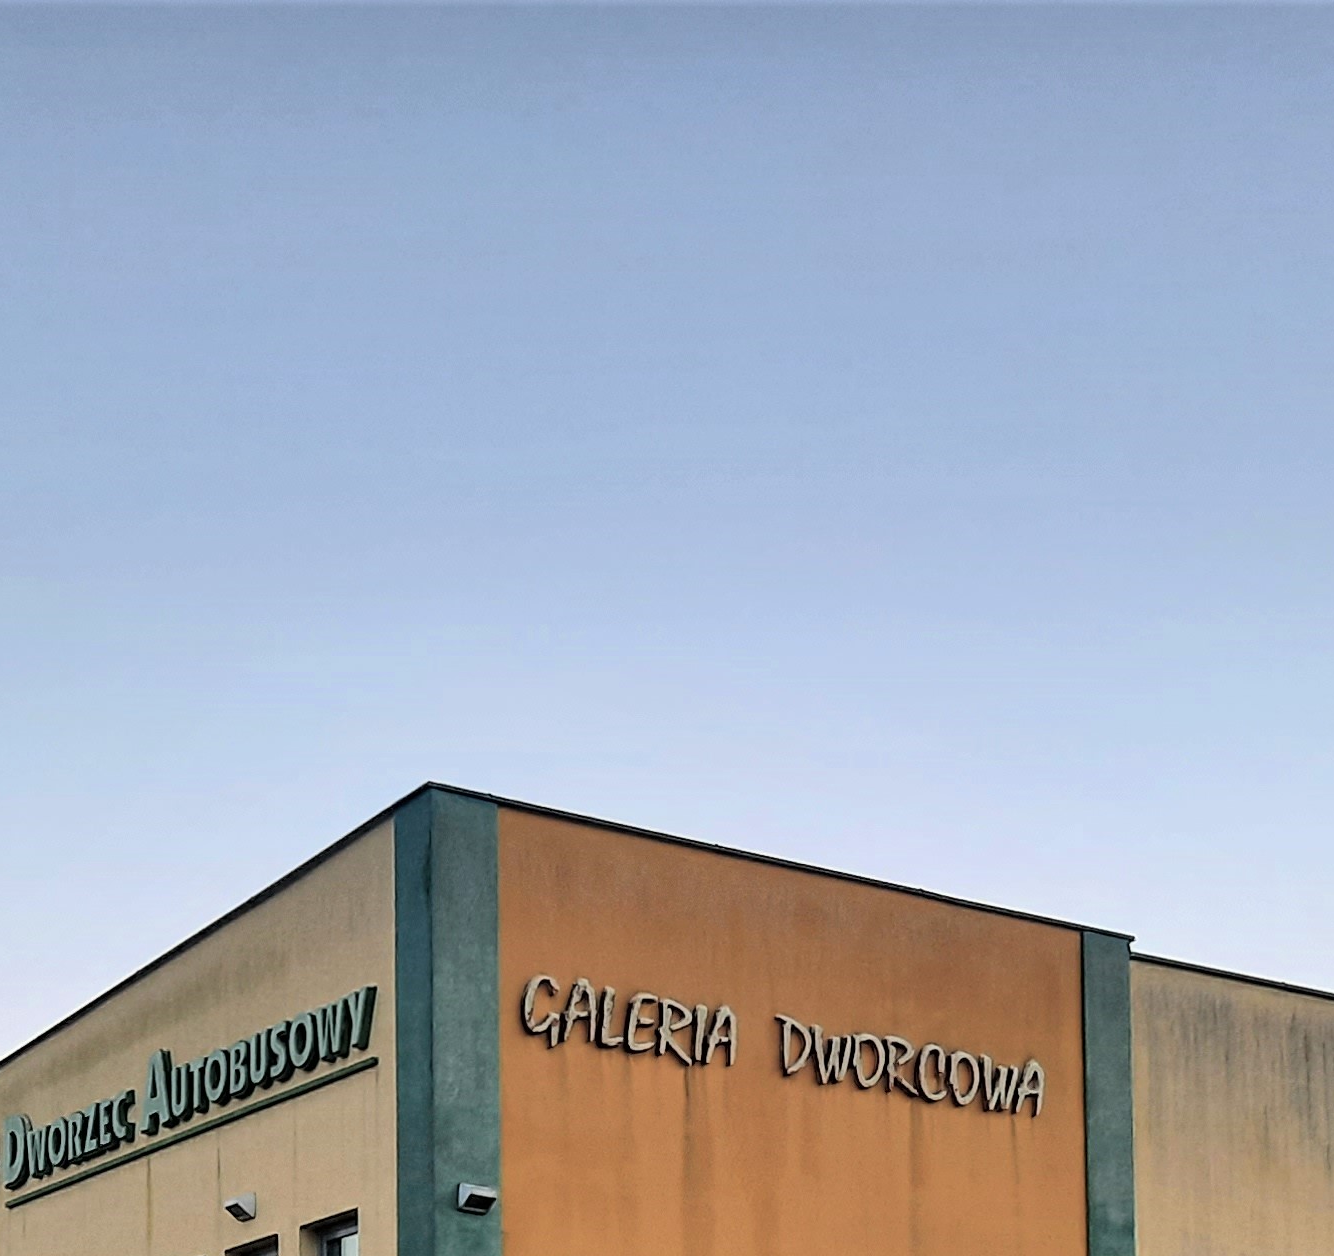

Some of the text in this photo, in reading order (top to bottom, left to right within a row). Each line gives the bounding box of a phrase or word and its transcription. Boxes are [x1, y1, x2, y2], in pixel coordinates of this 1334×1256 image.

[3, 986, 377, 1189] DWORZEC AUTOBUSOWY
[521, 973, 1046, 1117] GALERIA DWORCOWA
